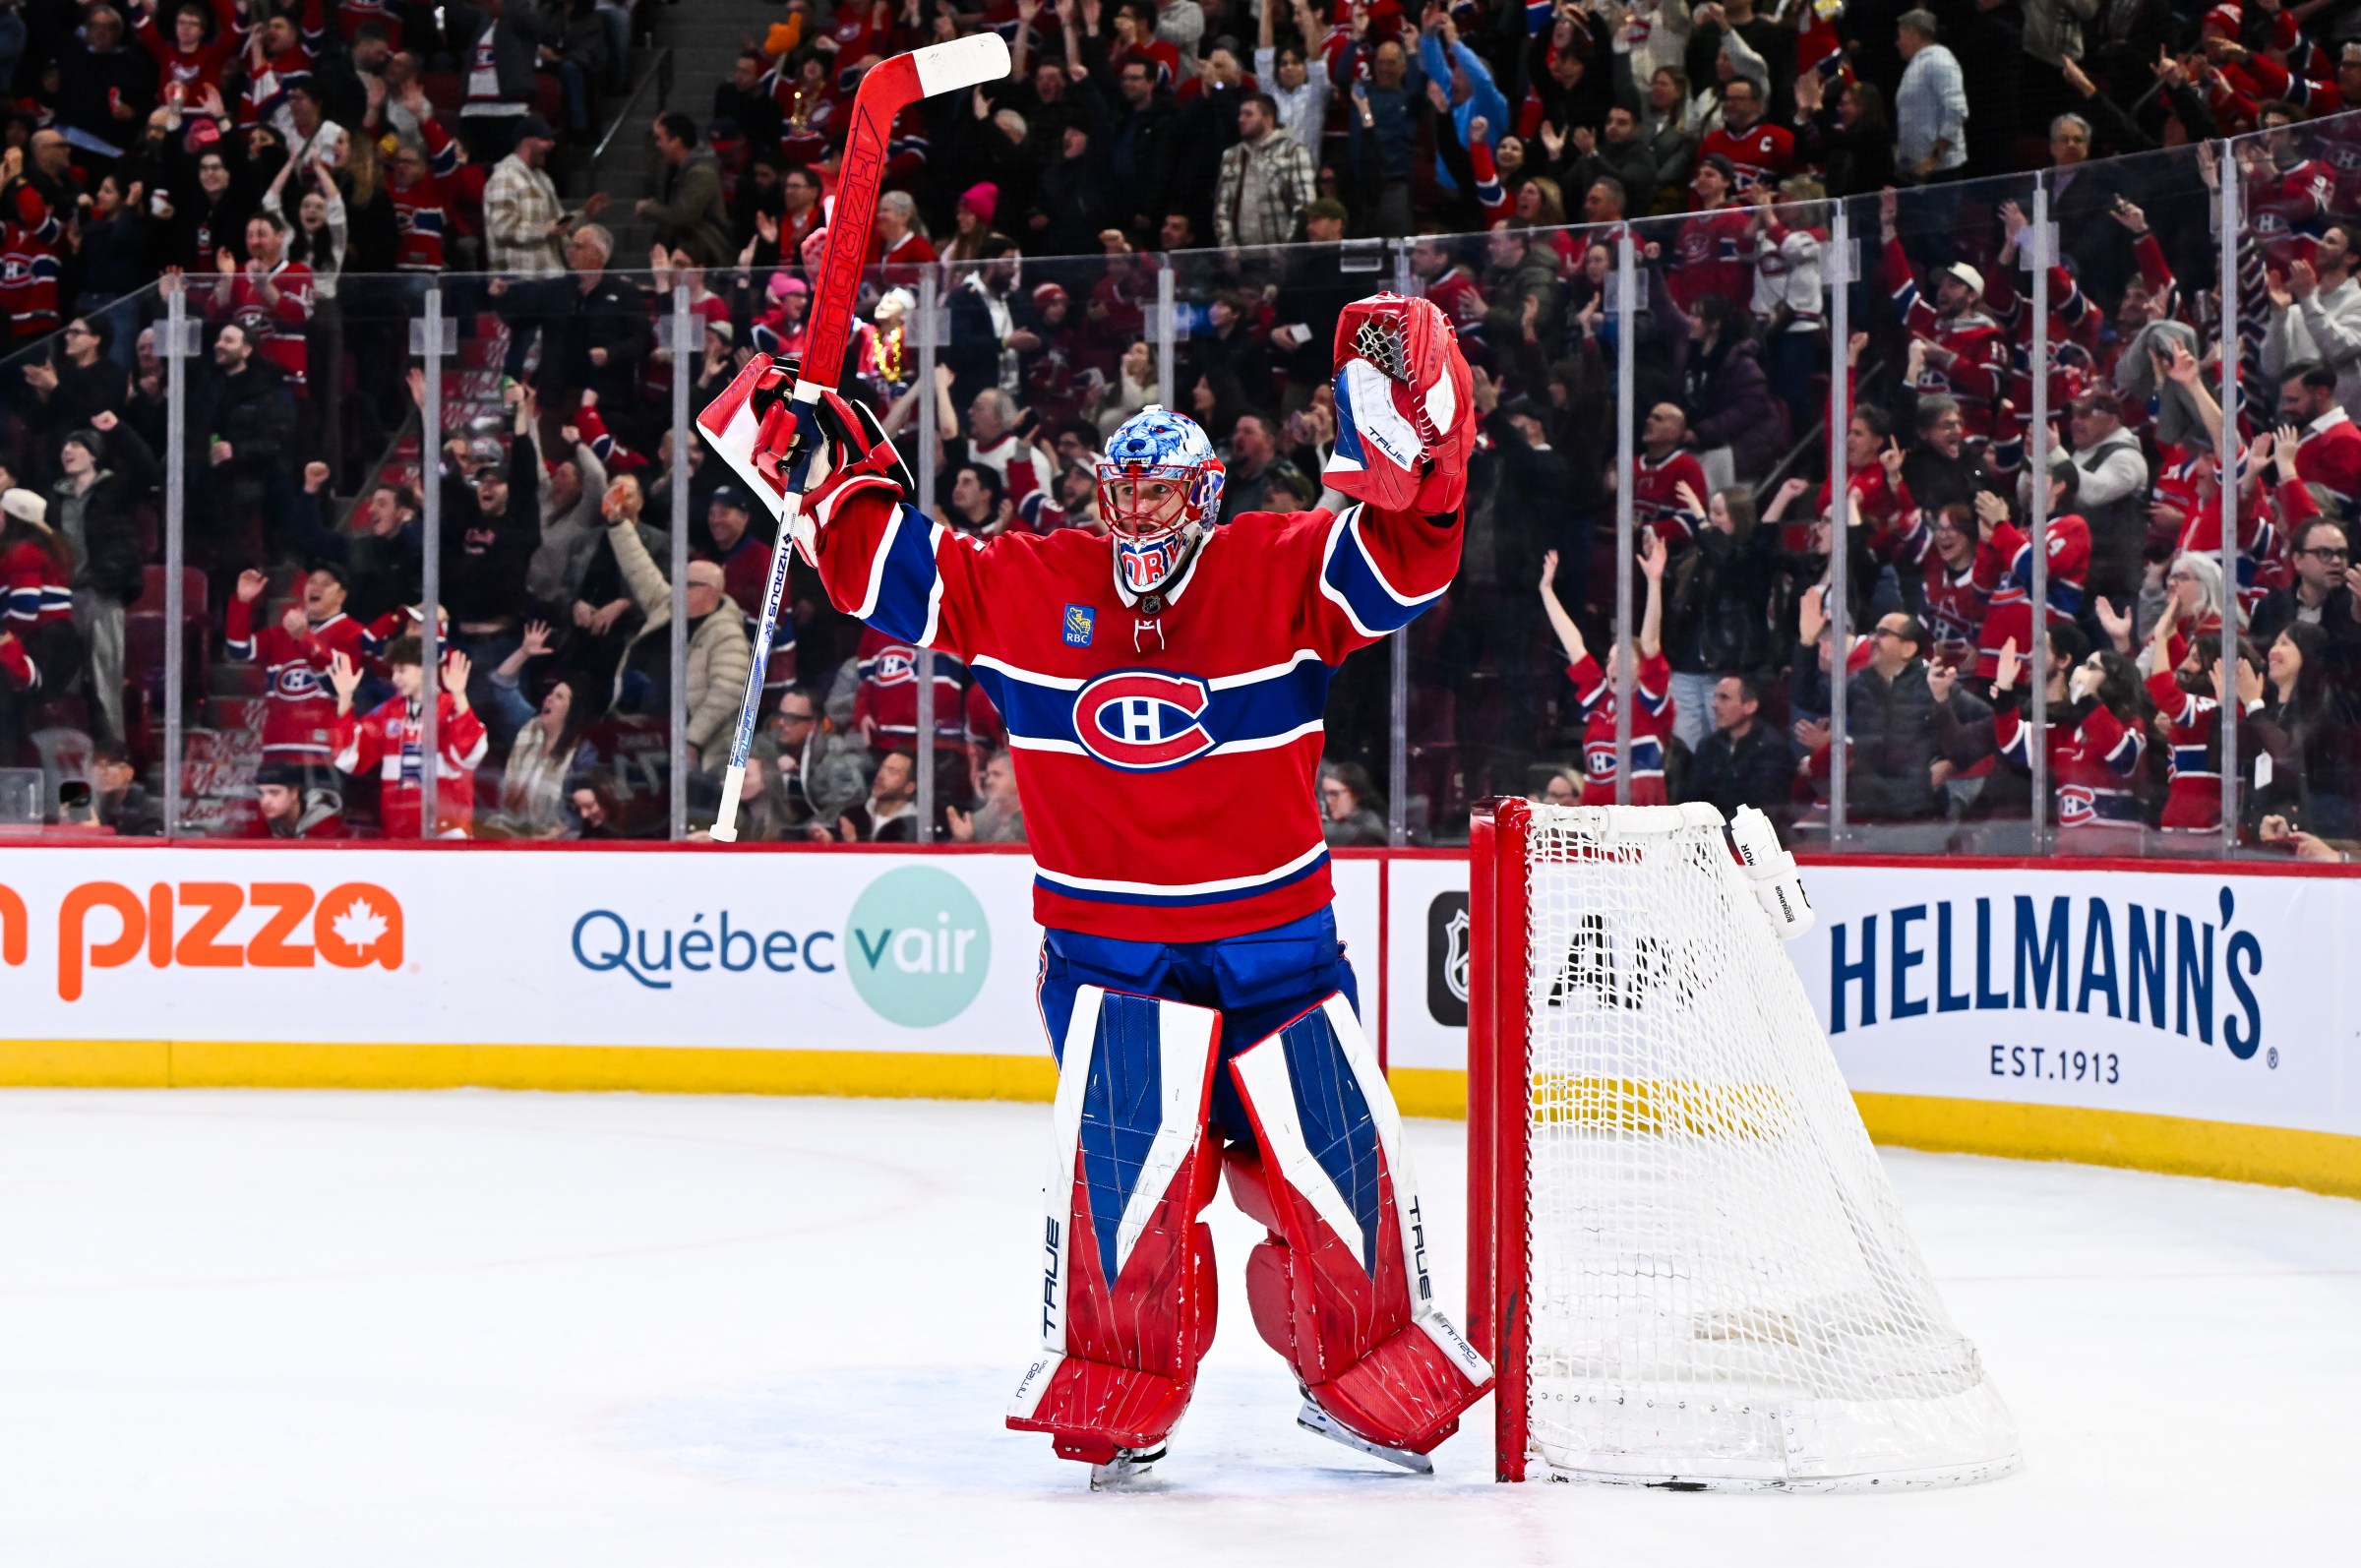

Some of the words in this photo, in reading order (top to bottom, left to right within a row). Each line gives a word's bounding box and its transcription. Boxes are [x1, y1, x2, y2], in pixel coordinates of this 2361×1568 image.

[813, 148, 878, 372] HZRDUS
[1368, 427, 1407, 466] TRUE
[767, 547, 789, 617] HZRDUS
[1066, 633, 1089, 644] RBC
[1775, 884, 1795, 924] BODYARMOR
[59, 882, 403, 1002] pizza
[572, 909, 836, 990] Québec
[854, 912, 976, 975] vair
[1830, 885, 2263, 1060] HELLMANN'S
[1043, 1215, 1060, 1339] TRUE
[1408, 1194, 1431, 1301] TRUE
[1441, 1323, 1478, 1360] NITRO
[1015, 1362, 1040, 1399] NITRO
